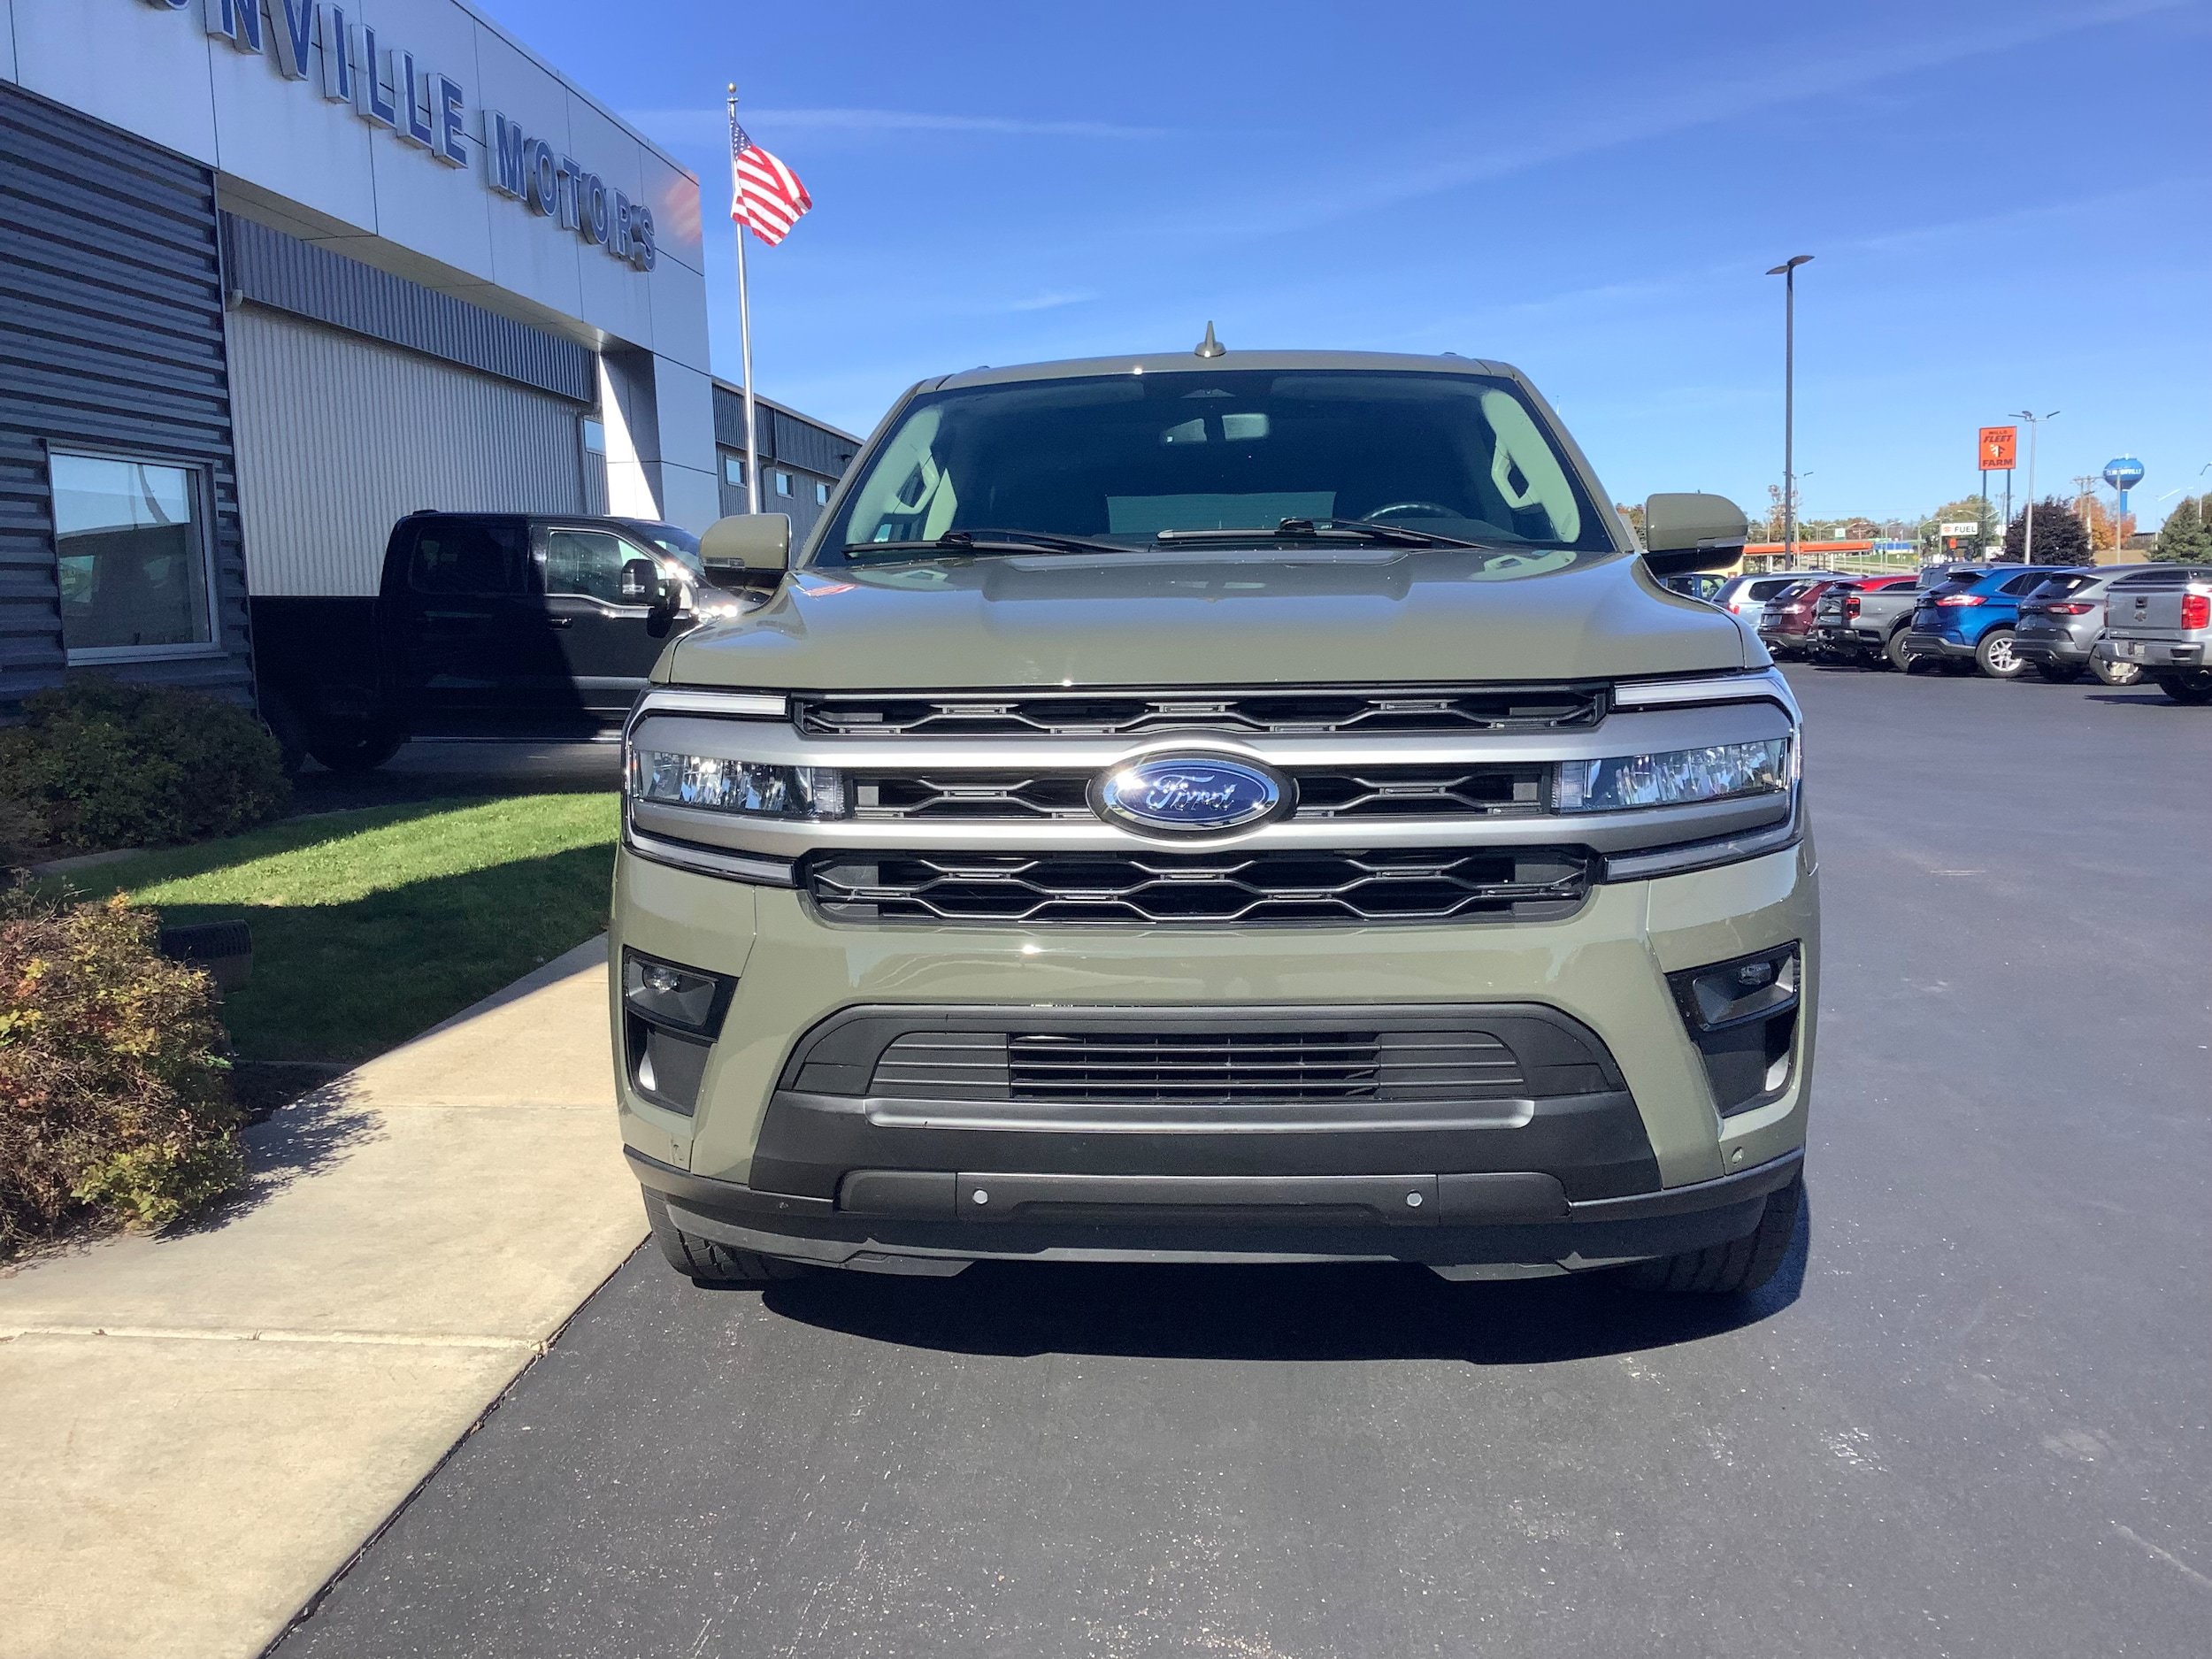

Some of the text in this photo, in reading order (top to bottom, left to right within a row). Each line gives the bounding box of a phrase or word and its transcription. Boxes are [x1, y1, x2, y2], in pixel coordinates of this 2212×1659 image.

[483, 109, 656, 272] MOTORS
[1983, 434, 2013, 443] FLEET
[1982, 458, 2013, 467] FARM
[1145, 773, 1239, 811] Ford
